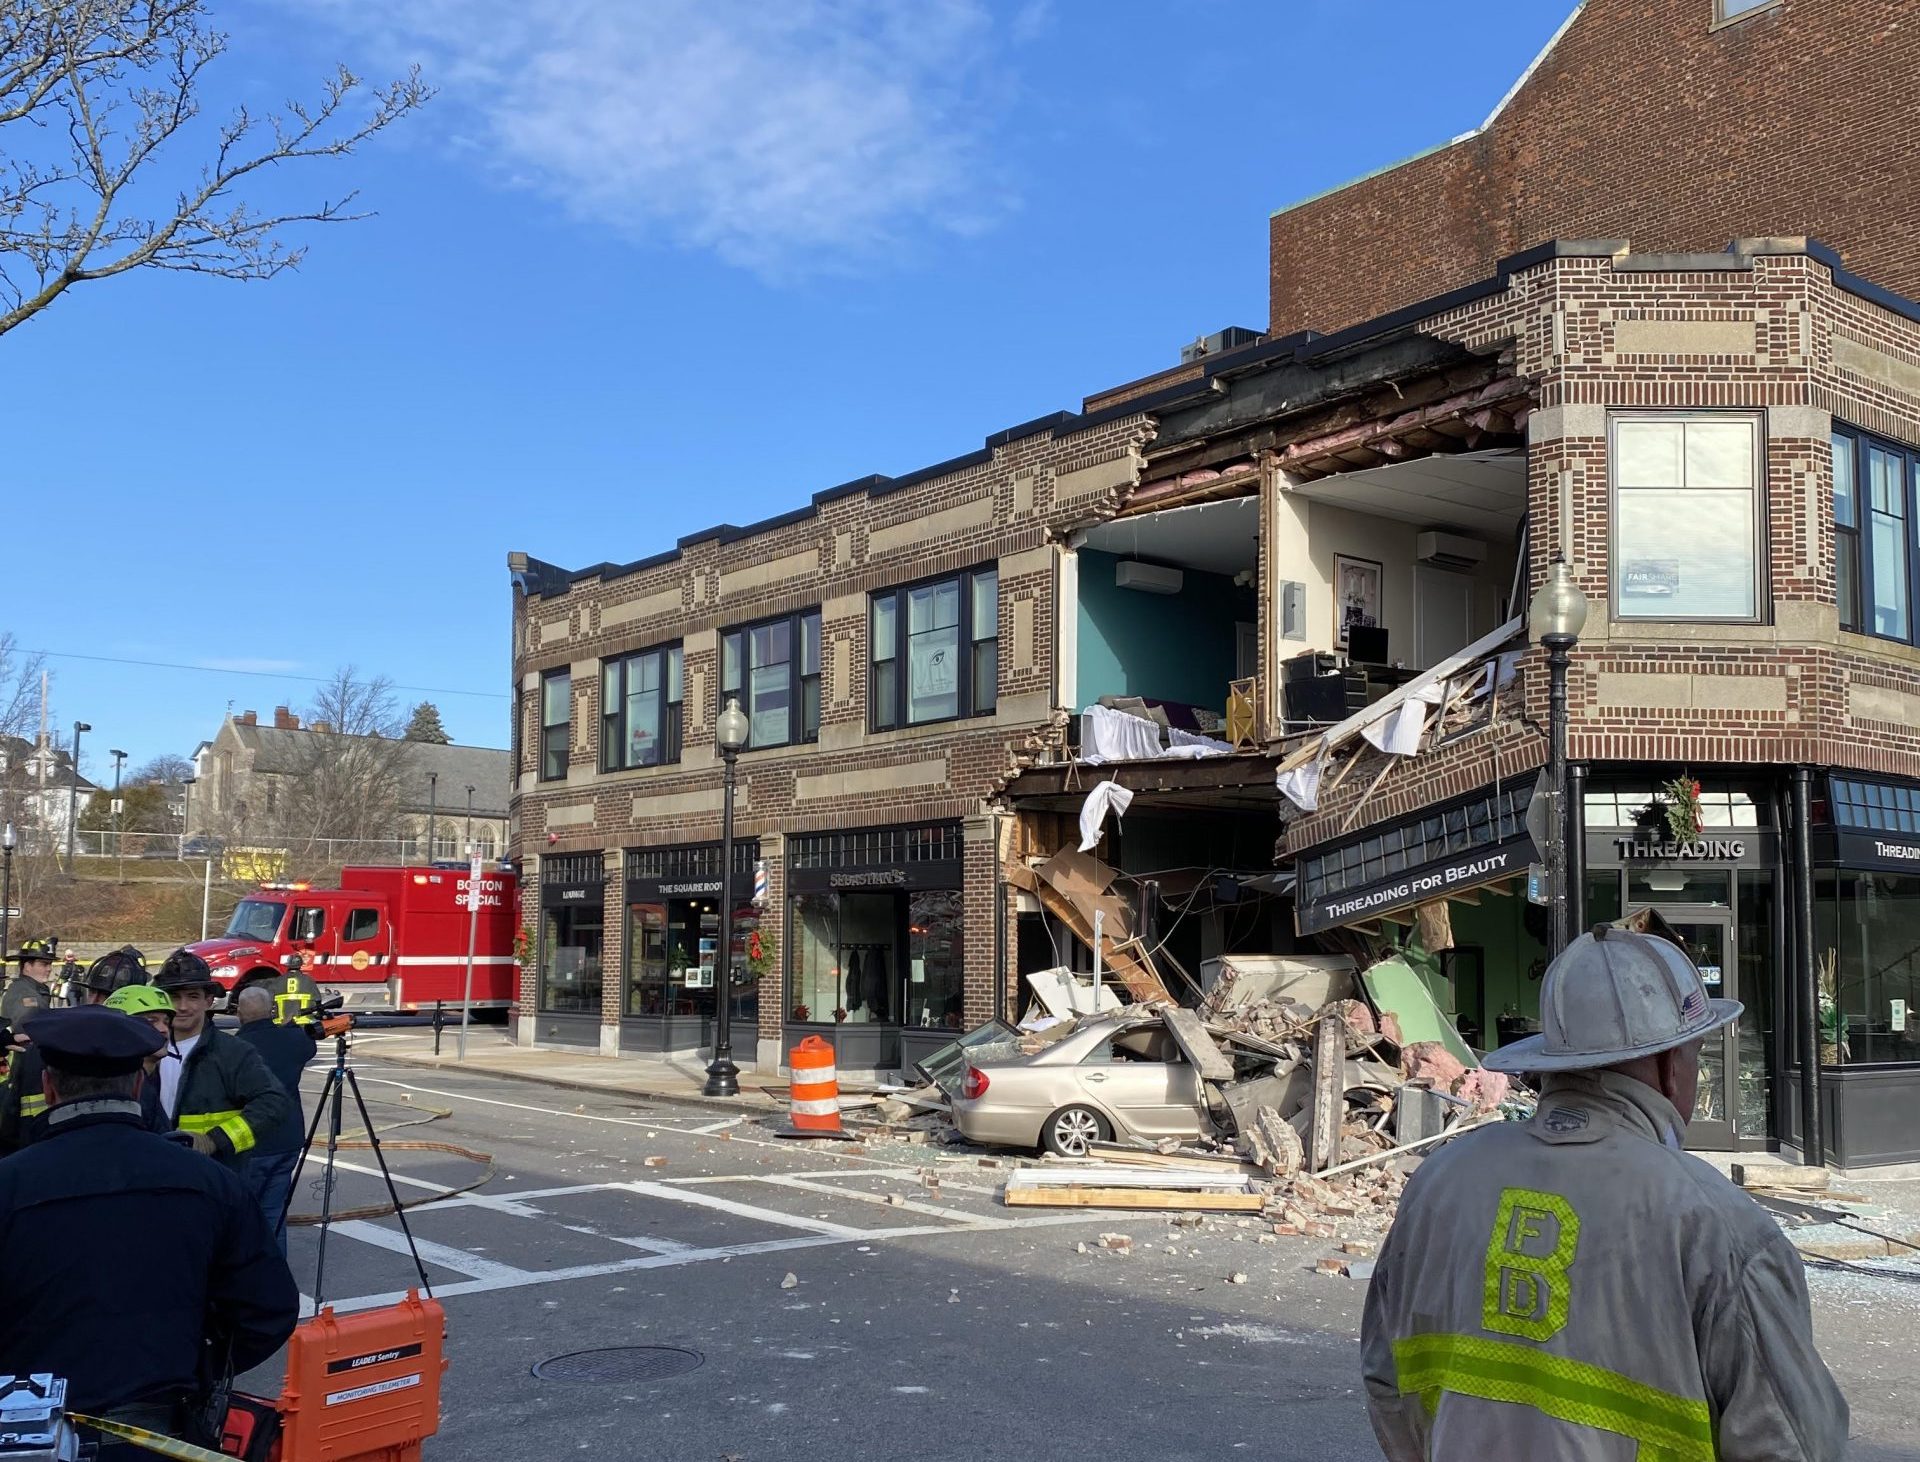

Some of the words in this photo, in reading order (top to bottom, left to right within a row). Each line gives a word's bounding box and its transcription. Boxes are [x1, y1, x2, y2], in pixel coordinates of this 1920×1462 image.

[1619, 837, 1745, 858] THREADING
[457, 880, 503, 891] BOTON
[658, 884, 673, 894] THE
[673, 883, 703, 893] SQUARE
[1325, 885, 1409, 919] THREADING
[1412, 875, 1443, 893] FOR
[1445, 853, 1508, 883] BEAUTY
[455, 894, 502, 906] SPCIAL
[562, 890, 585, 899] LOUNGE
[352, 1355, 376, 1367] LEADER
[377, 1351, 400, 1362] Sentry
[336, 1387, 378, 1401] MONITORING
[378, 1378, 411, 1391] TELEMETER
